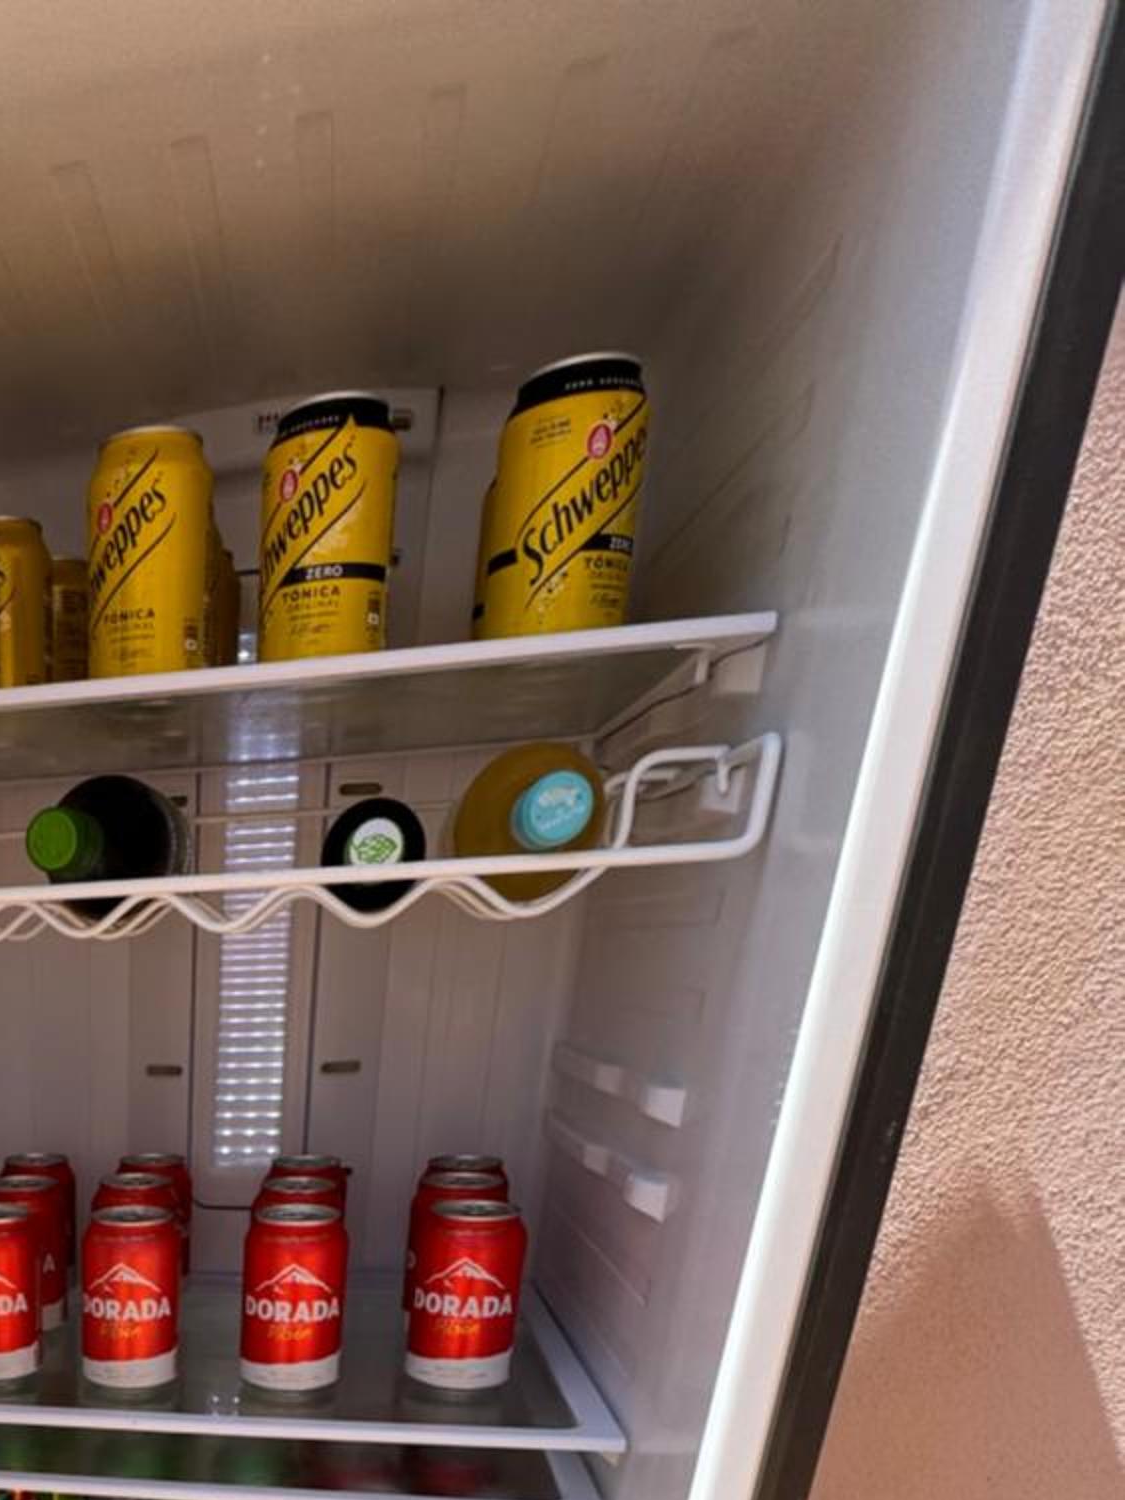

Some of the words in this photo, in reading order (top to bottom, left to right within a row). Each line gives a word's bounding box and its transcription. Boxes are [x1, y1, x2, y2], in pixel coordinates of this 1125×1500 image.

[523, 424, 647, 586] Schweppe
[305, 565, 342, 581] ZERO
[244, 1295, 339, 1322] DORADA
[413, 1287, 512, 1318] DORADA
